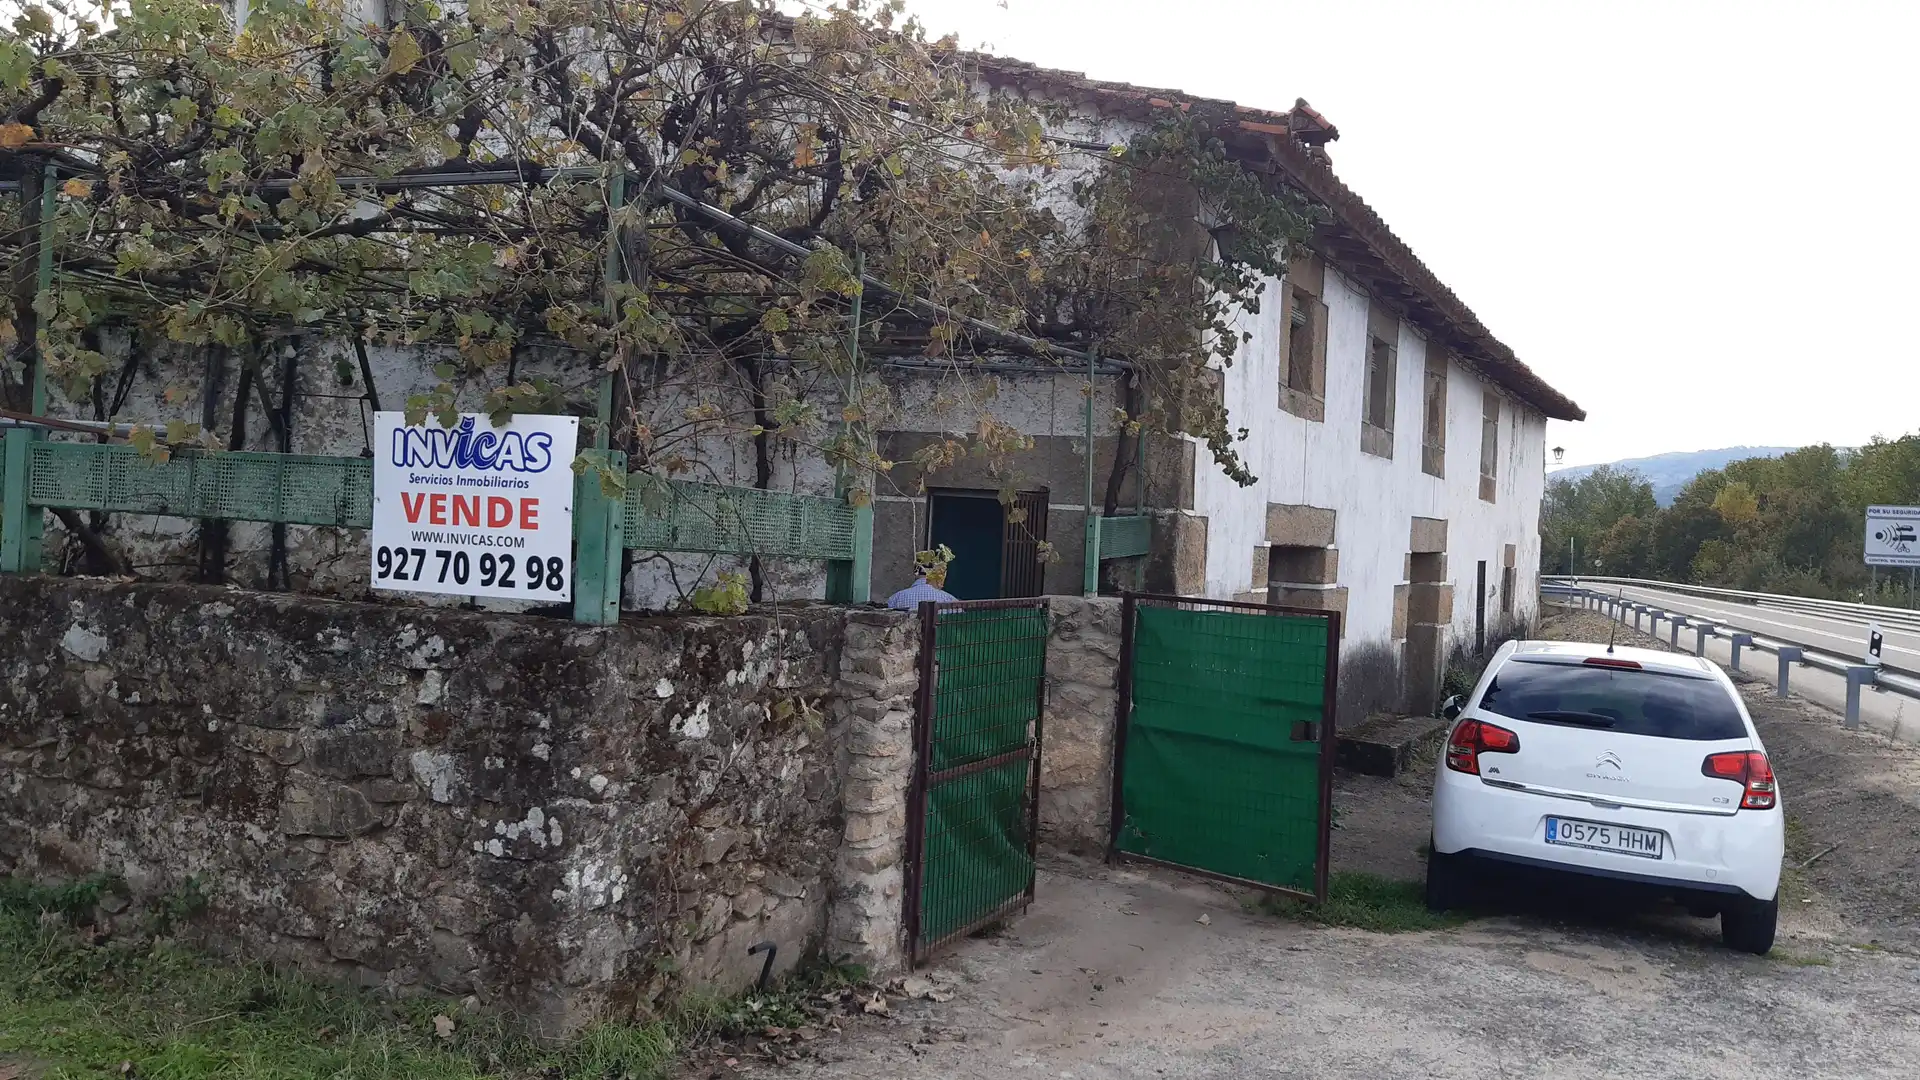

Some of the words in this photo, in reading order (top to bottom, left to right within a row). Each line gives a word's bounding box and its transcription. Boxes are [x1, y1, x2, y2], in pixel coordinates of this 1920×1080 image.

[409, 472, 453, 486] Servicios
[456, 475, 529, 489] Inmobiliarios
[400, 491, 540, 530] VENDE
[411, 530, 525, 549] WWW.INVICAS.COM
[377, 546, 427, 582] 927
[435, 549, 470, 586] 70
[479, 552, 516, 589] 92
[526, 555, 564, 592] 98
[1712, 796, 1730, 804] C3
[1561, 822, 1611, 845] 0575
[1618, 830, 1657, 852] HHM
